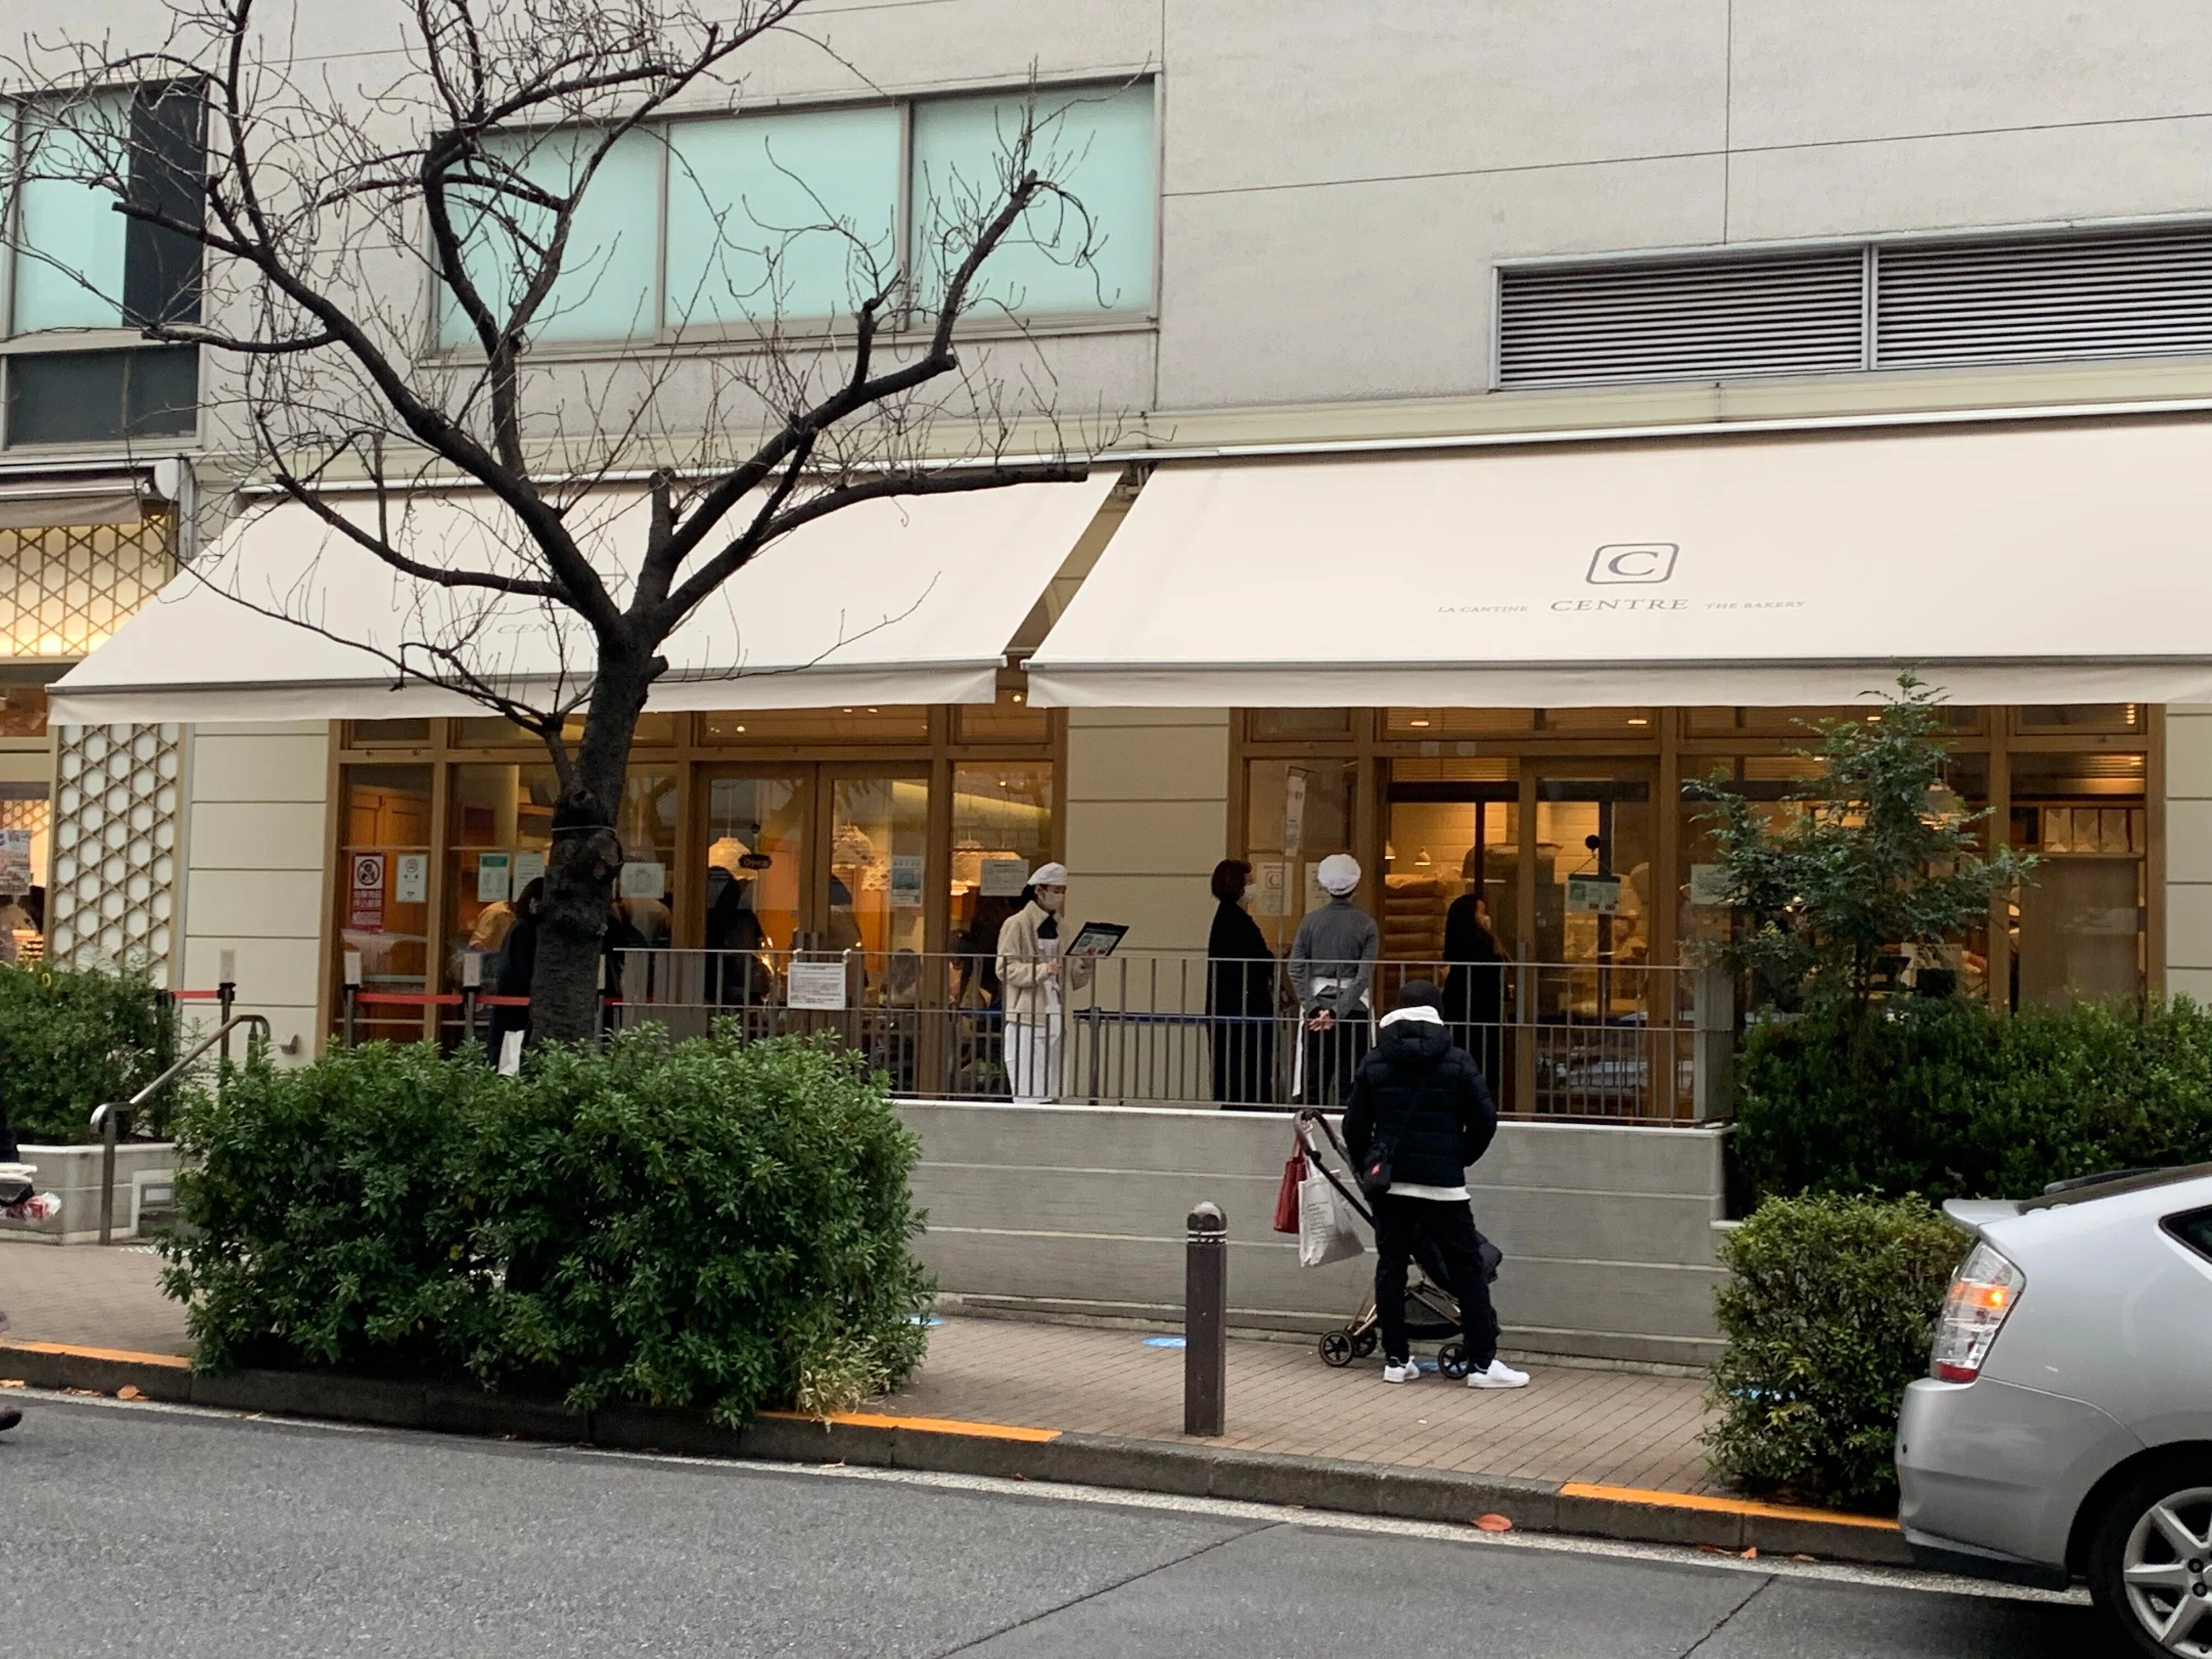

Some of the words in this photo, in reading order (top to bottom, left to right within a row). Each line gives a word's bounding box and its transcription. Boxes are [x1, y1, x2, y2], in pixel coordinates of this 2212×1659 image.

[1607, 550, 1659, 577] C
[1459, 605, 1528, 613] CANTINE
[1550, 599, 1688, 612] CENTRE
[1743, 601, 1807, 609] BAKERY
